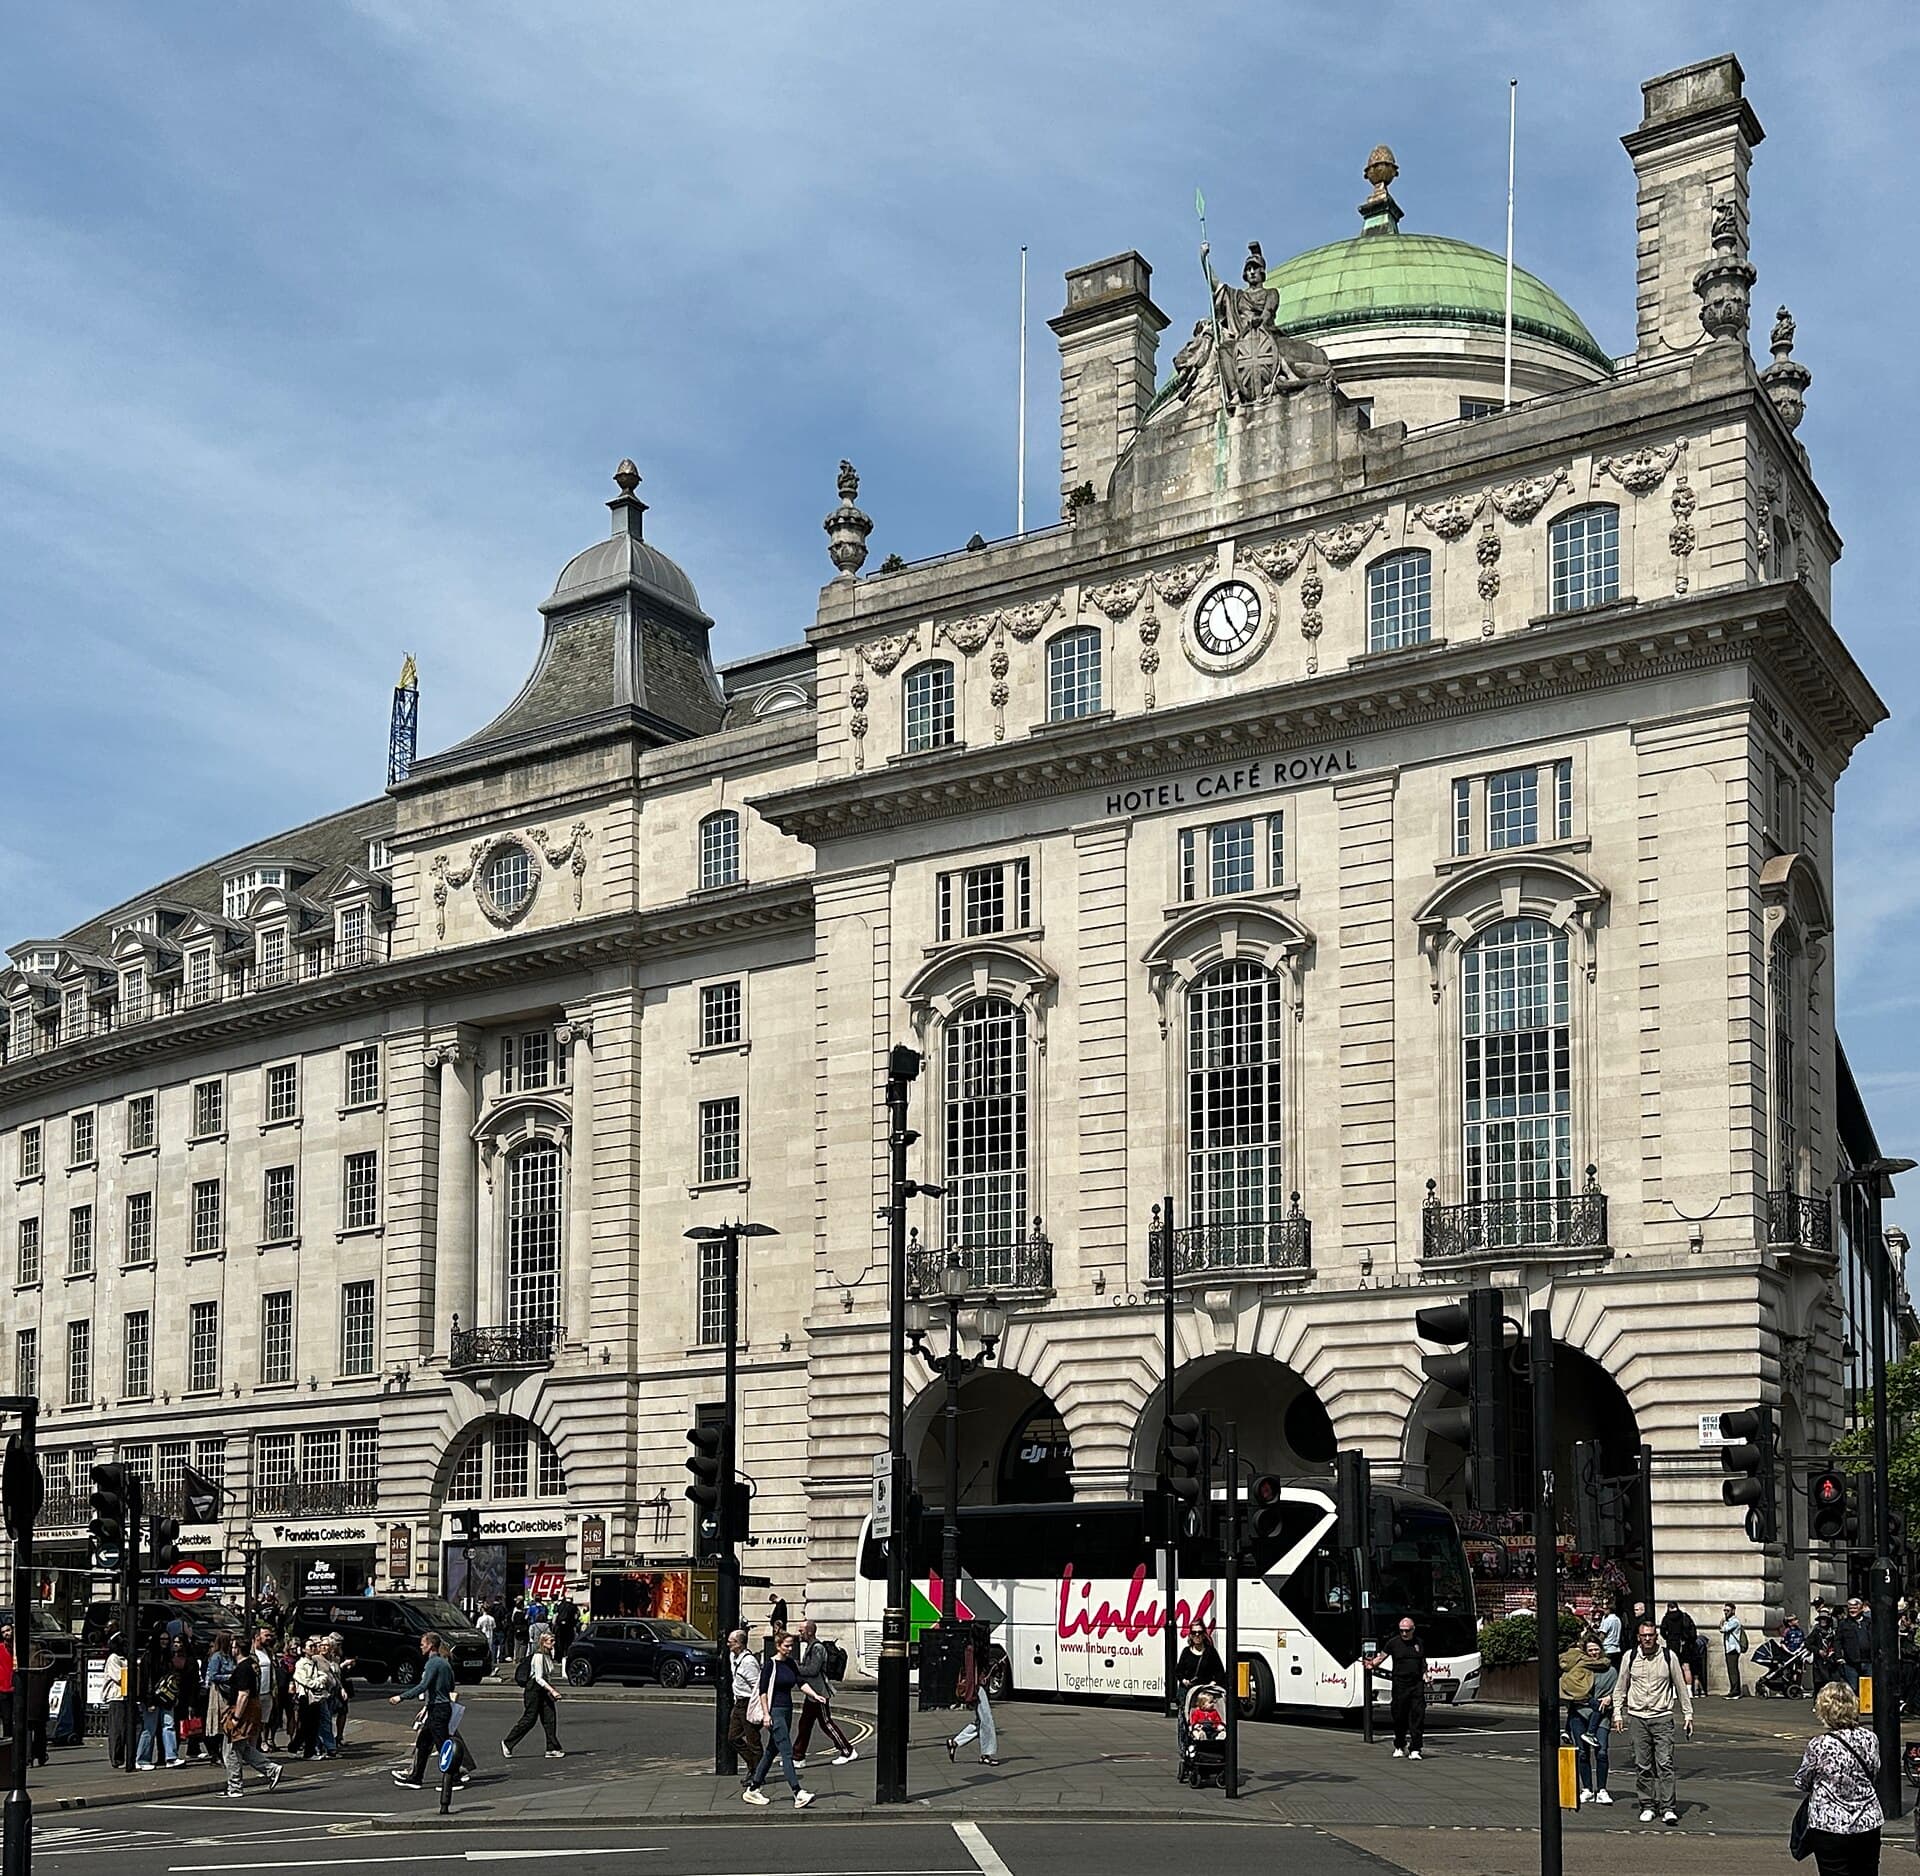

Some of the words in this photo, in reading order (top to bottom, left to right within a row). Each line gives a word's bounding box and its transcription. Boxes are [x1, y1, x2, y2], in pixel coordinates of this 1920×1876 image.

[1106, 783, 1185, 815] HOTEL
[1196, 762, 1260, 797] CAFÉ
[1274, 750, 1358, 784] ROYAL
[508, 1518, 563, 1533] Collectibles
[284, 1528, 320, 1542] Fanatics
[320, 1527, 366, 1540] Collectibles
[160, 1577, 217, 1585] UNDERGROUND
[308, 1571, 336, 1580] Chrome
[1060, 1642, 1144, 1657] www.linburg.co.uk
[1064, 1673, 1103, 1690] Together
[1106, 1678, 1121, 1688] we
[1123, 1678, 1139, 1689] can
[1142, 1676, 1165, 1690] reall
